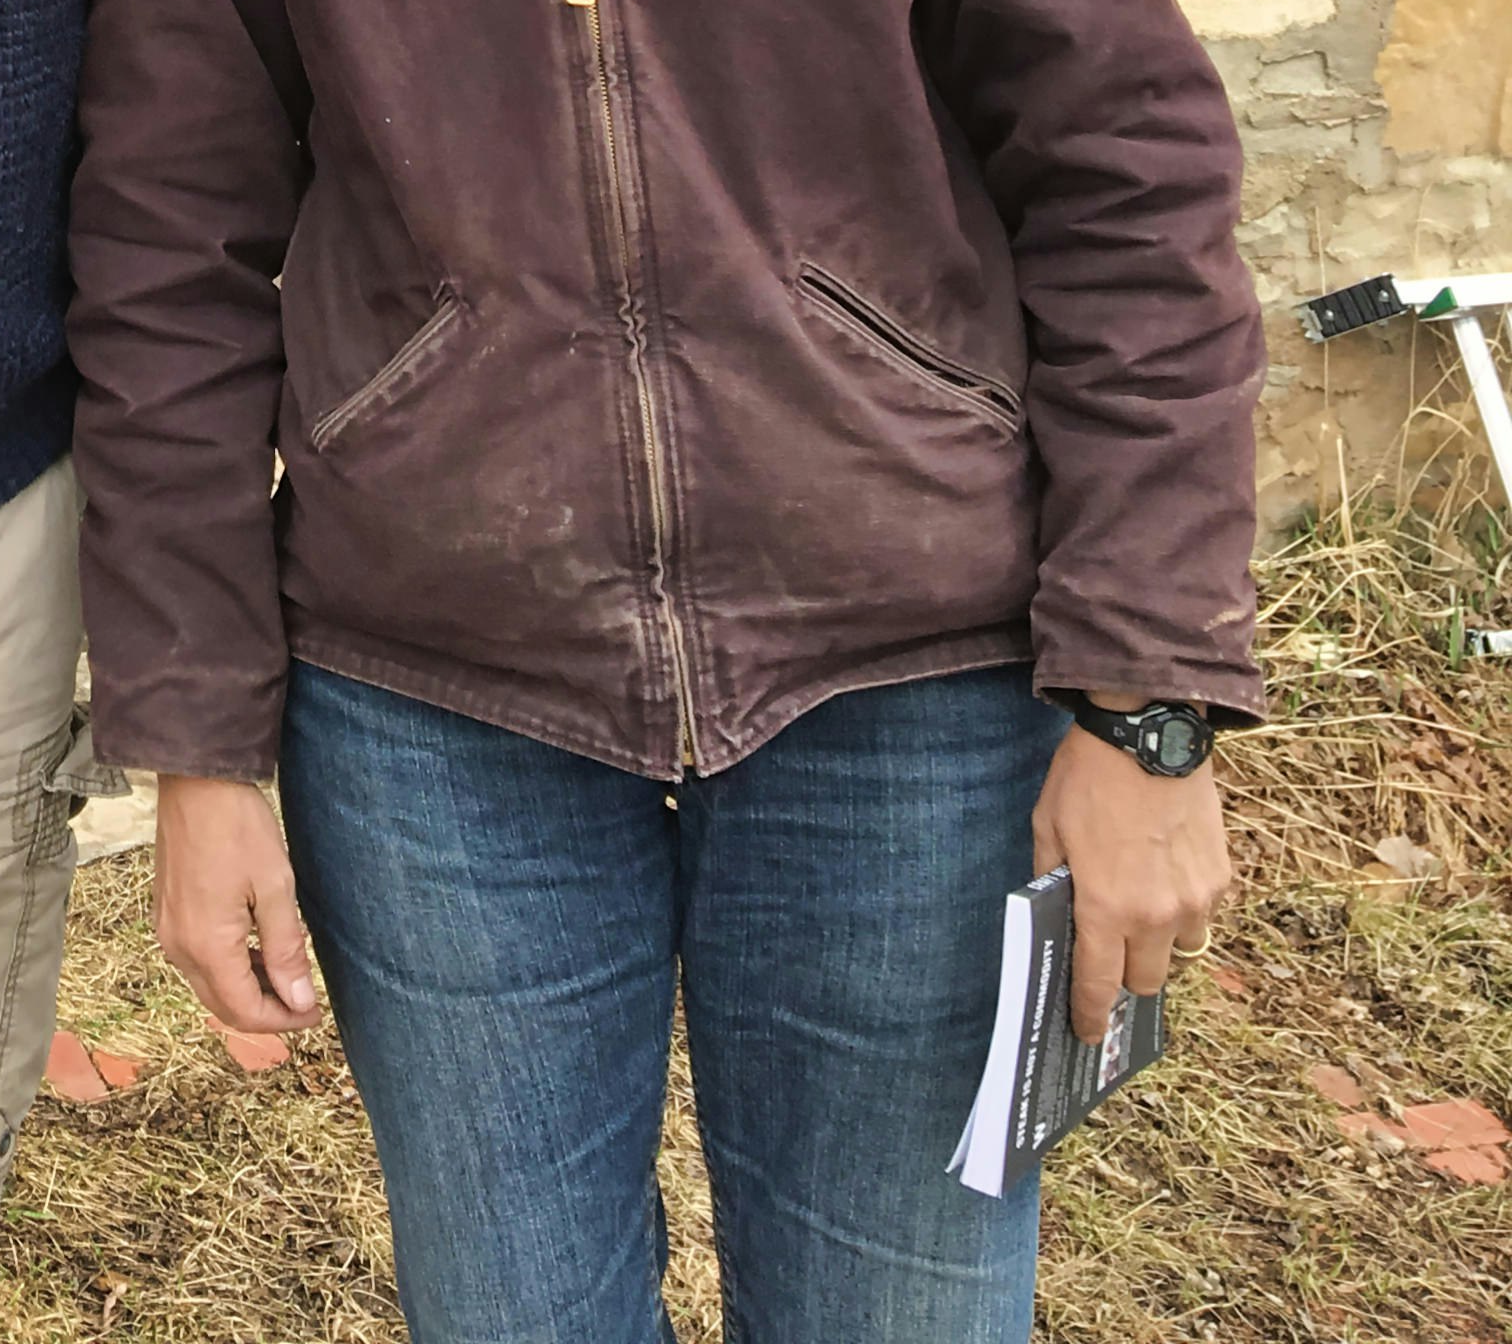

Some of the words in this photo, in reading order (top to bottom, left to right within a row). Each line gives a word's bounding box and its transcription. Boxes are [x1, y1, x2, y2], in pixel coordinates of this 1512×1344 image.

[1032, 939, 1055, 1031] COMMODITY
[1030, 1031, 1041, 1043] A
[1025, 1047, 1038, 1078] NOT
[1022, 1078, 1033, 1097] IS
[1015, 1097, 1030, 1149] STEAK
